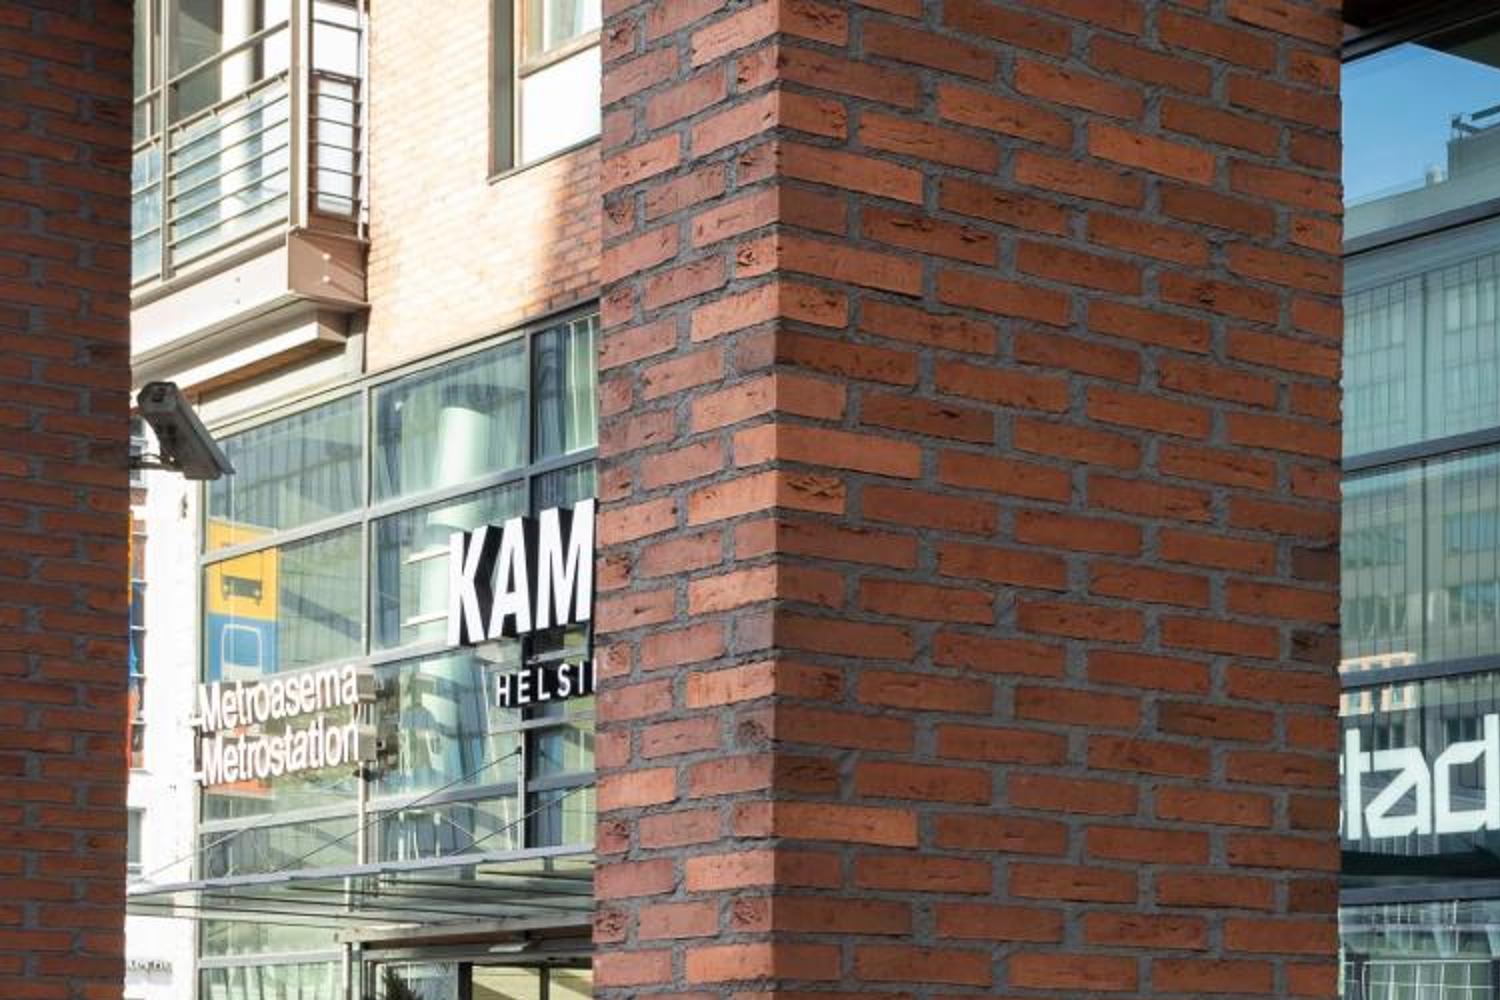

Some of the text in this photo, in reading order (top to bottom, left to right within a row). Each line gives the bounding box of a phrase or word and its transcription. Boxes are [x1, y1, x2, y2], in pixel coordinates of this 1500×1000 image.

[199, 664, 359, 732] Metroasema
[496, 658, 597, 706] HELSI
[200, 713, 359, 786] Metrostation
